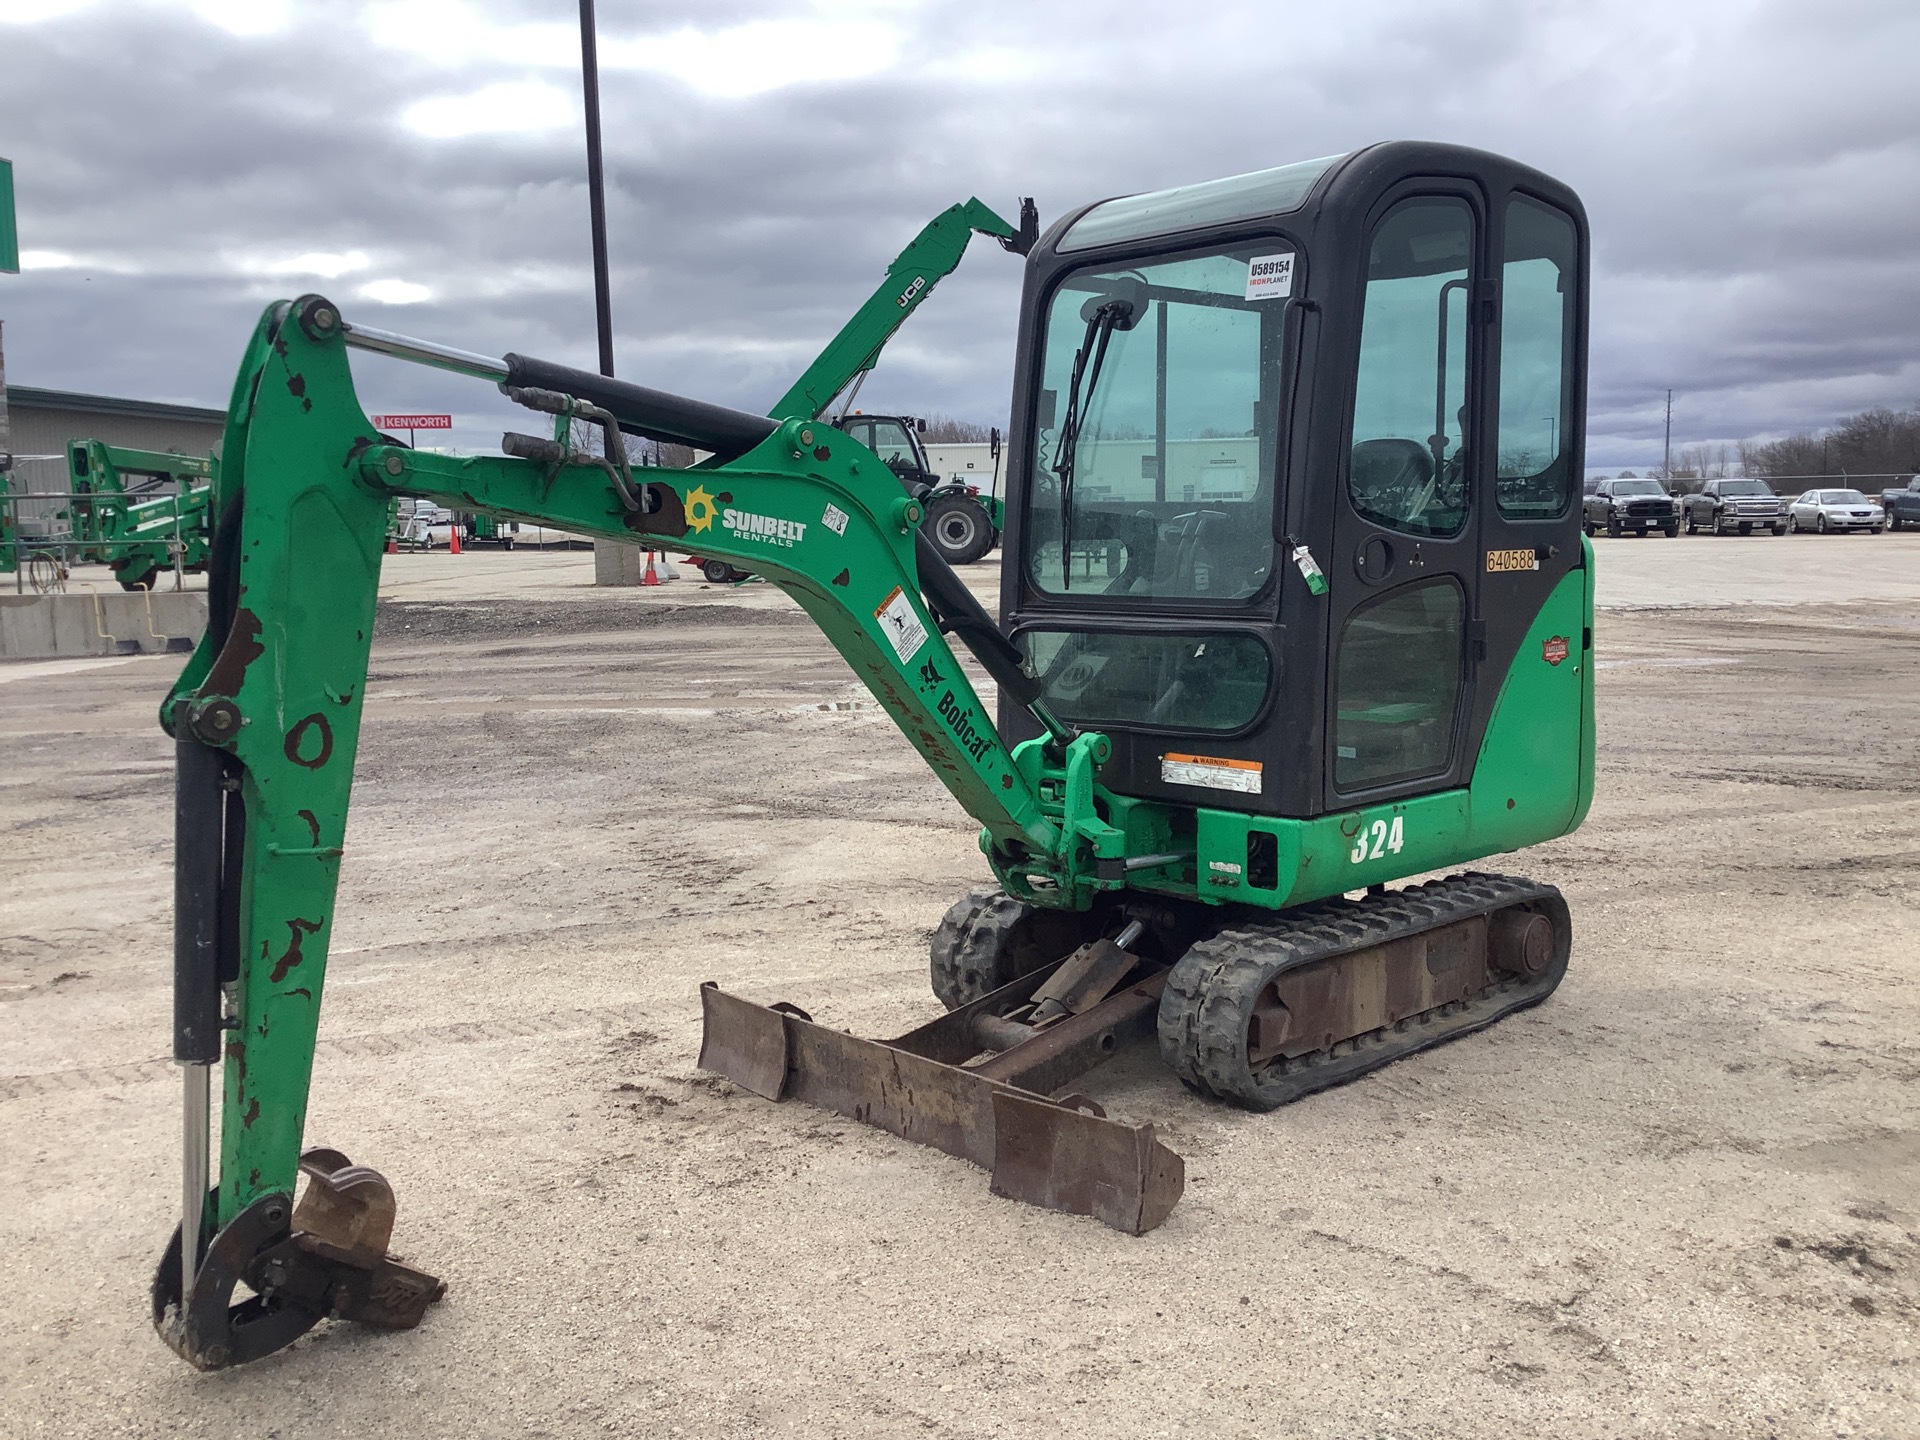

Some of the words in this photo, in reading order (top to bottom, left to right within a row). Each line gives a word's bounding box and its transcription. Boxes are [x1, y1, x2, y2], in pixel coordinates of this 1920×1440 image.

[1251, 260, 1290, 276] U589154
[1250, 276, 1288, 286] IRONPLANET
[897, 276, 926, 307] JCB
[386, 416, 449, 427] KENWORTH
[722, 508, 807, 542] SUNBELT
[733, 530, 794, 548] RENTALS
[1488, 550, 1534, 570] 640588
[937, 689, 992, 763] Bobcat
[1200, 758, 1229, 767] WARNING
[1350, 816, 1404, 865] 324
